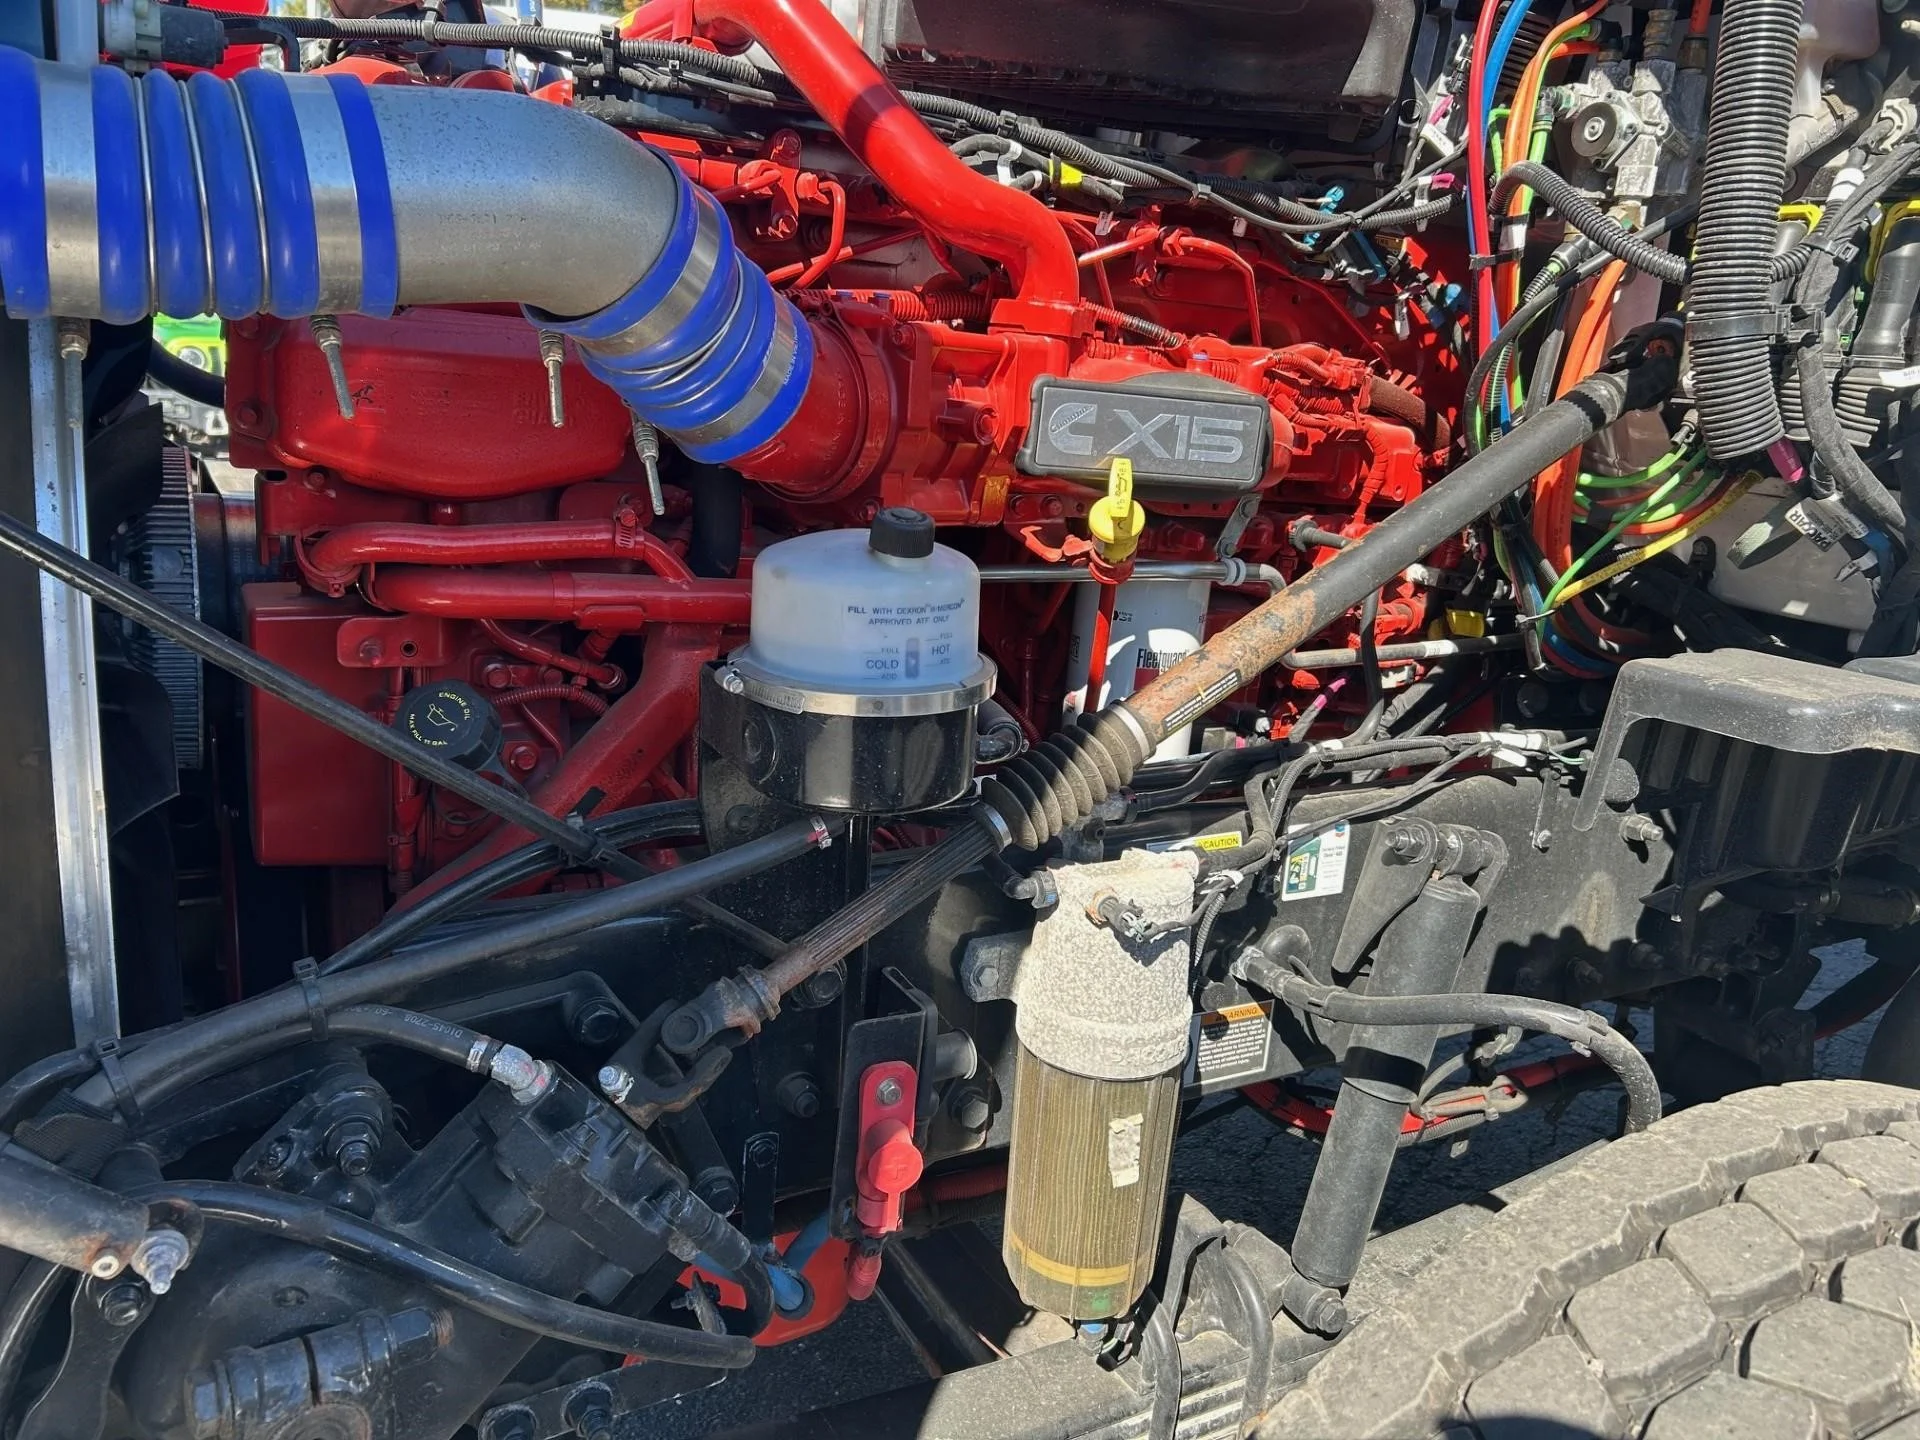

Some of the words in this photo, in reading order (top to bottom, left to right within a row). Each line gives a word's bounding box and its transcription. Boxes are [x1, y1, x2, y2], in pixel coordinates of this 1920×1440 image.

[1107, 407, 1244, 464] X15
[1789, 508, 1831, 548] PACCAR
[848, 606, 866, 614] FILL
[872, 607, 892, 615] WITH
[916, 617, 930, 625] ATF
[933, 615, 950, 624] ONLY
[931, 643, 950, 656] HOT
[865, 659, 899, 670] COLD
[438, 691, 467, 708] ENGINE
[463, 708, 471, 721] OIL
[412, 729, 422, 742] FILL
[1203, 838, 1239, 849] CAUTION
